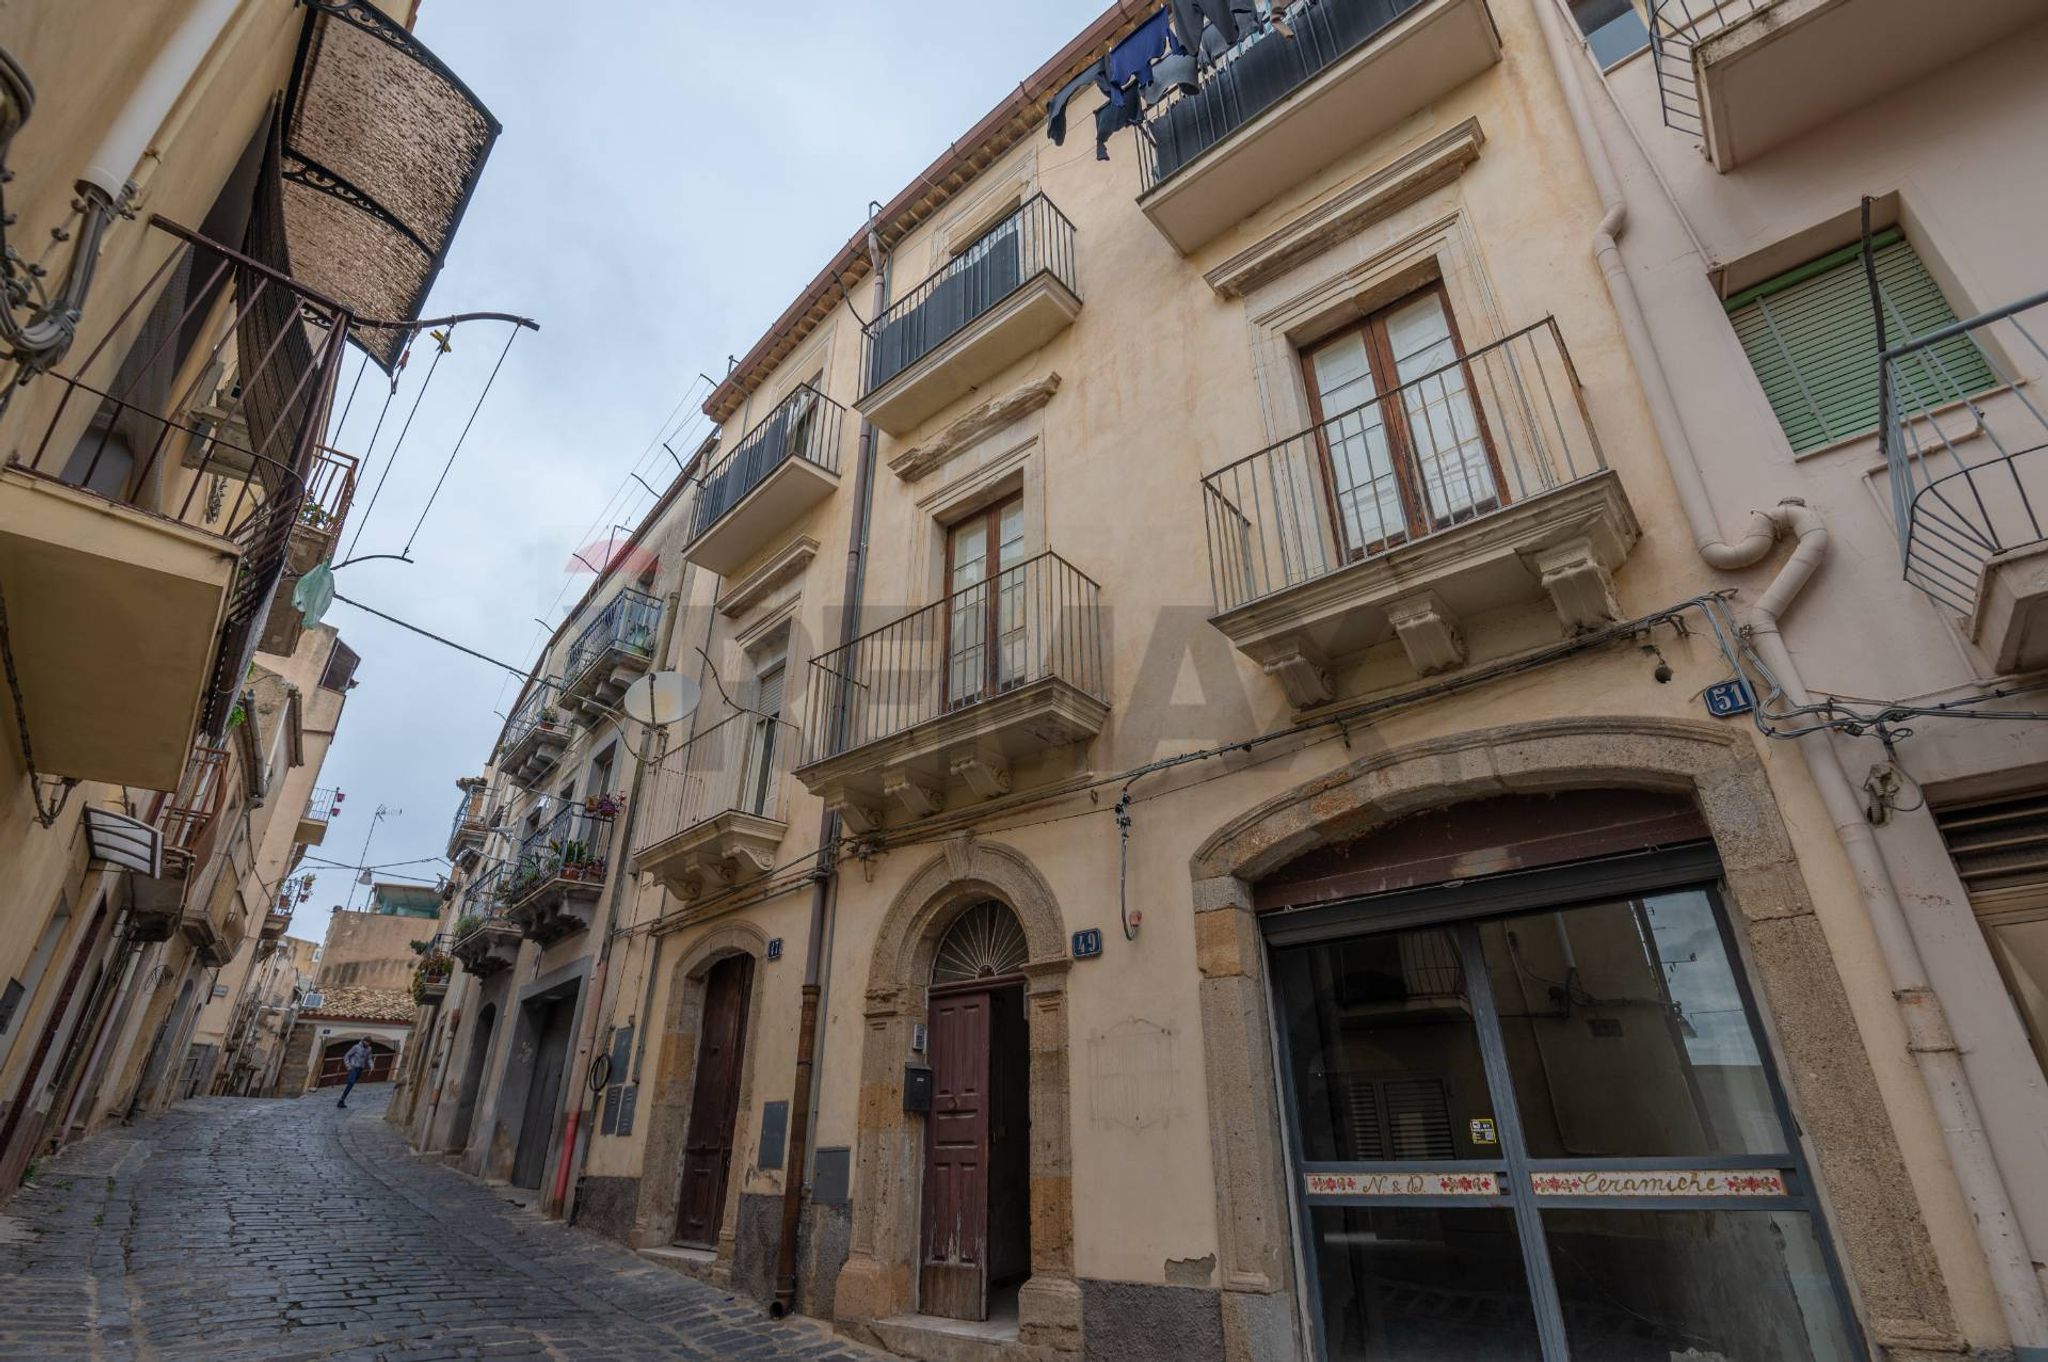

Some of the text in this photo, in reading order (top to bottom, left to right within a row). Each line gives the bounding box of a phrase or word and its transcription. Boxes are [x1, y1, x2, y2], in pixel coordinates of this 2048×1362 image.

[1712, 684, 1747, 710] 51
[1078, 933, 1096, 953] 49
[1392, 1180, 1402, 1193] &
[1577, 1171, 1722, 1193] Ceramiche
